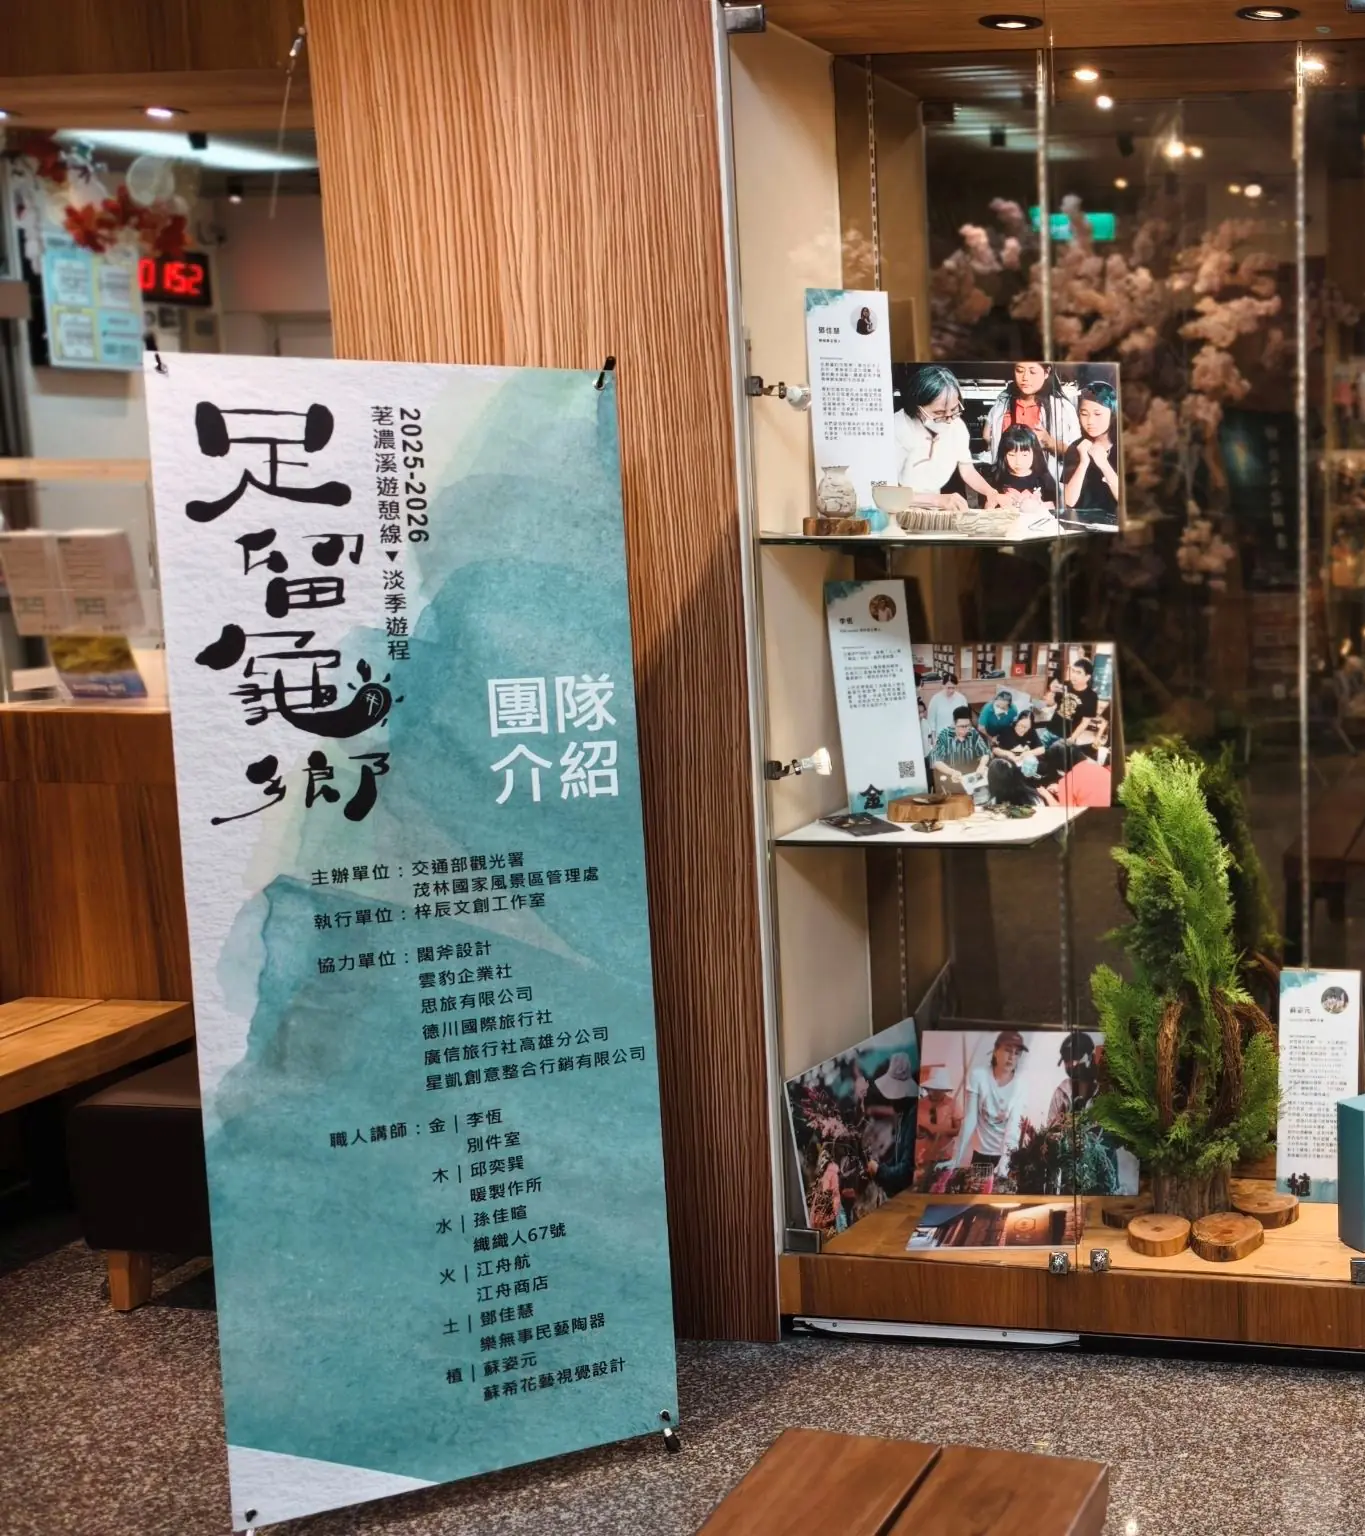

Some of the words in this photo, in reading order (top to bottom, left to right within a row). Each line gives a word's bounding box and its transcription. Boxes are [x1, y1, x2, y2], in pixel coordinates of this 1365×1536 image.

[371, 405, 403, 545] 荖濃溪遊憩線
[400, 407, 430, 543] 2025-2026
[382, 569, 411, 661] 淡季遊程
[487, 673, 617, 738] 團隊
[490, 741, 620, 805] 介紹
[412, 866, 599, 898] 茂林國家風景區管理處
[418, 963, 513, 989] 雲豹企業社
[420, 986, 533, 1014] 思旅有限公司
[422, 1009, 553, 1041] 德川國際旅行社
[424, 1026, 609, 1066] 廣信旅行社高雄分公司
[425, 1046, 646, 1091] 星凱創意整合行銷有限公司
[467, 1131, 521, 1153] 別件室
[470, 1176, 542, 1203] 暖製作所
[477, 1275, 549, 1303] 江舟商店
[483, 1356, 627, 1402] 蘇希花藝視覺設計
